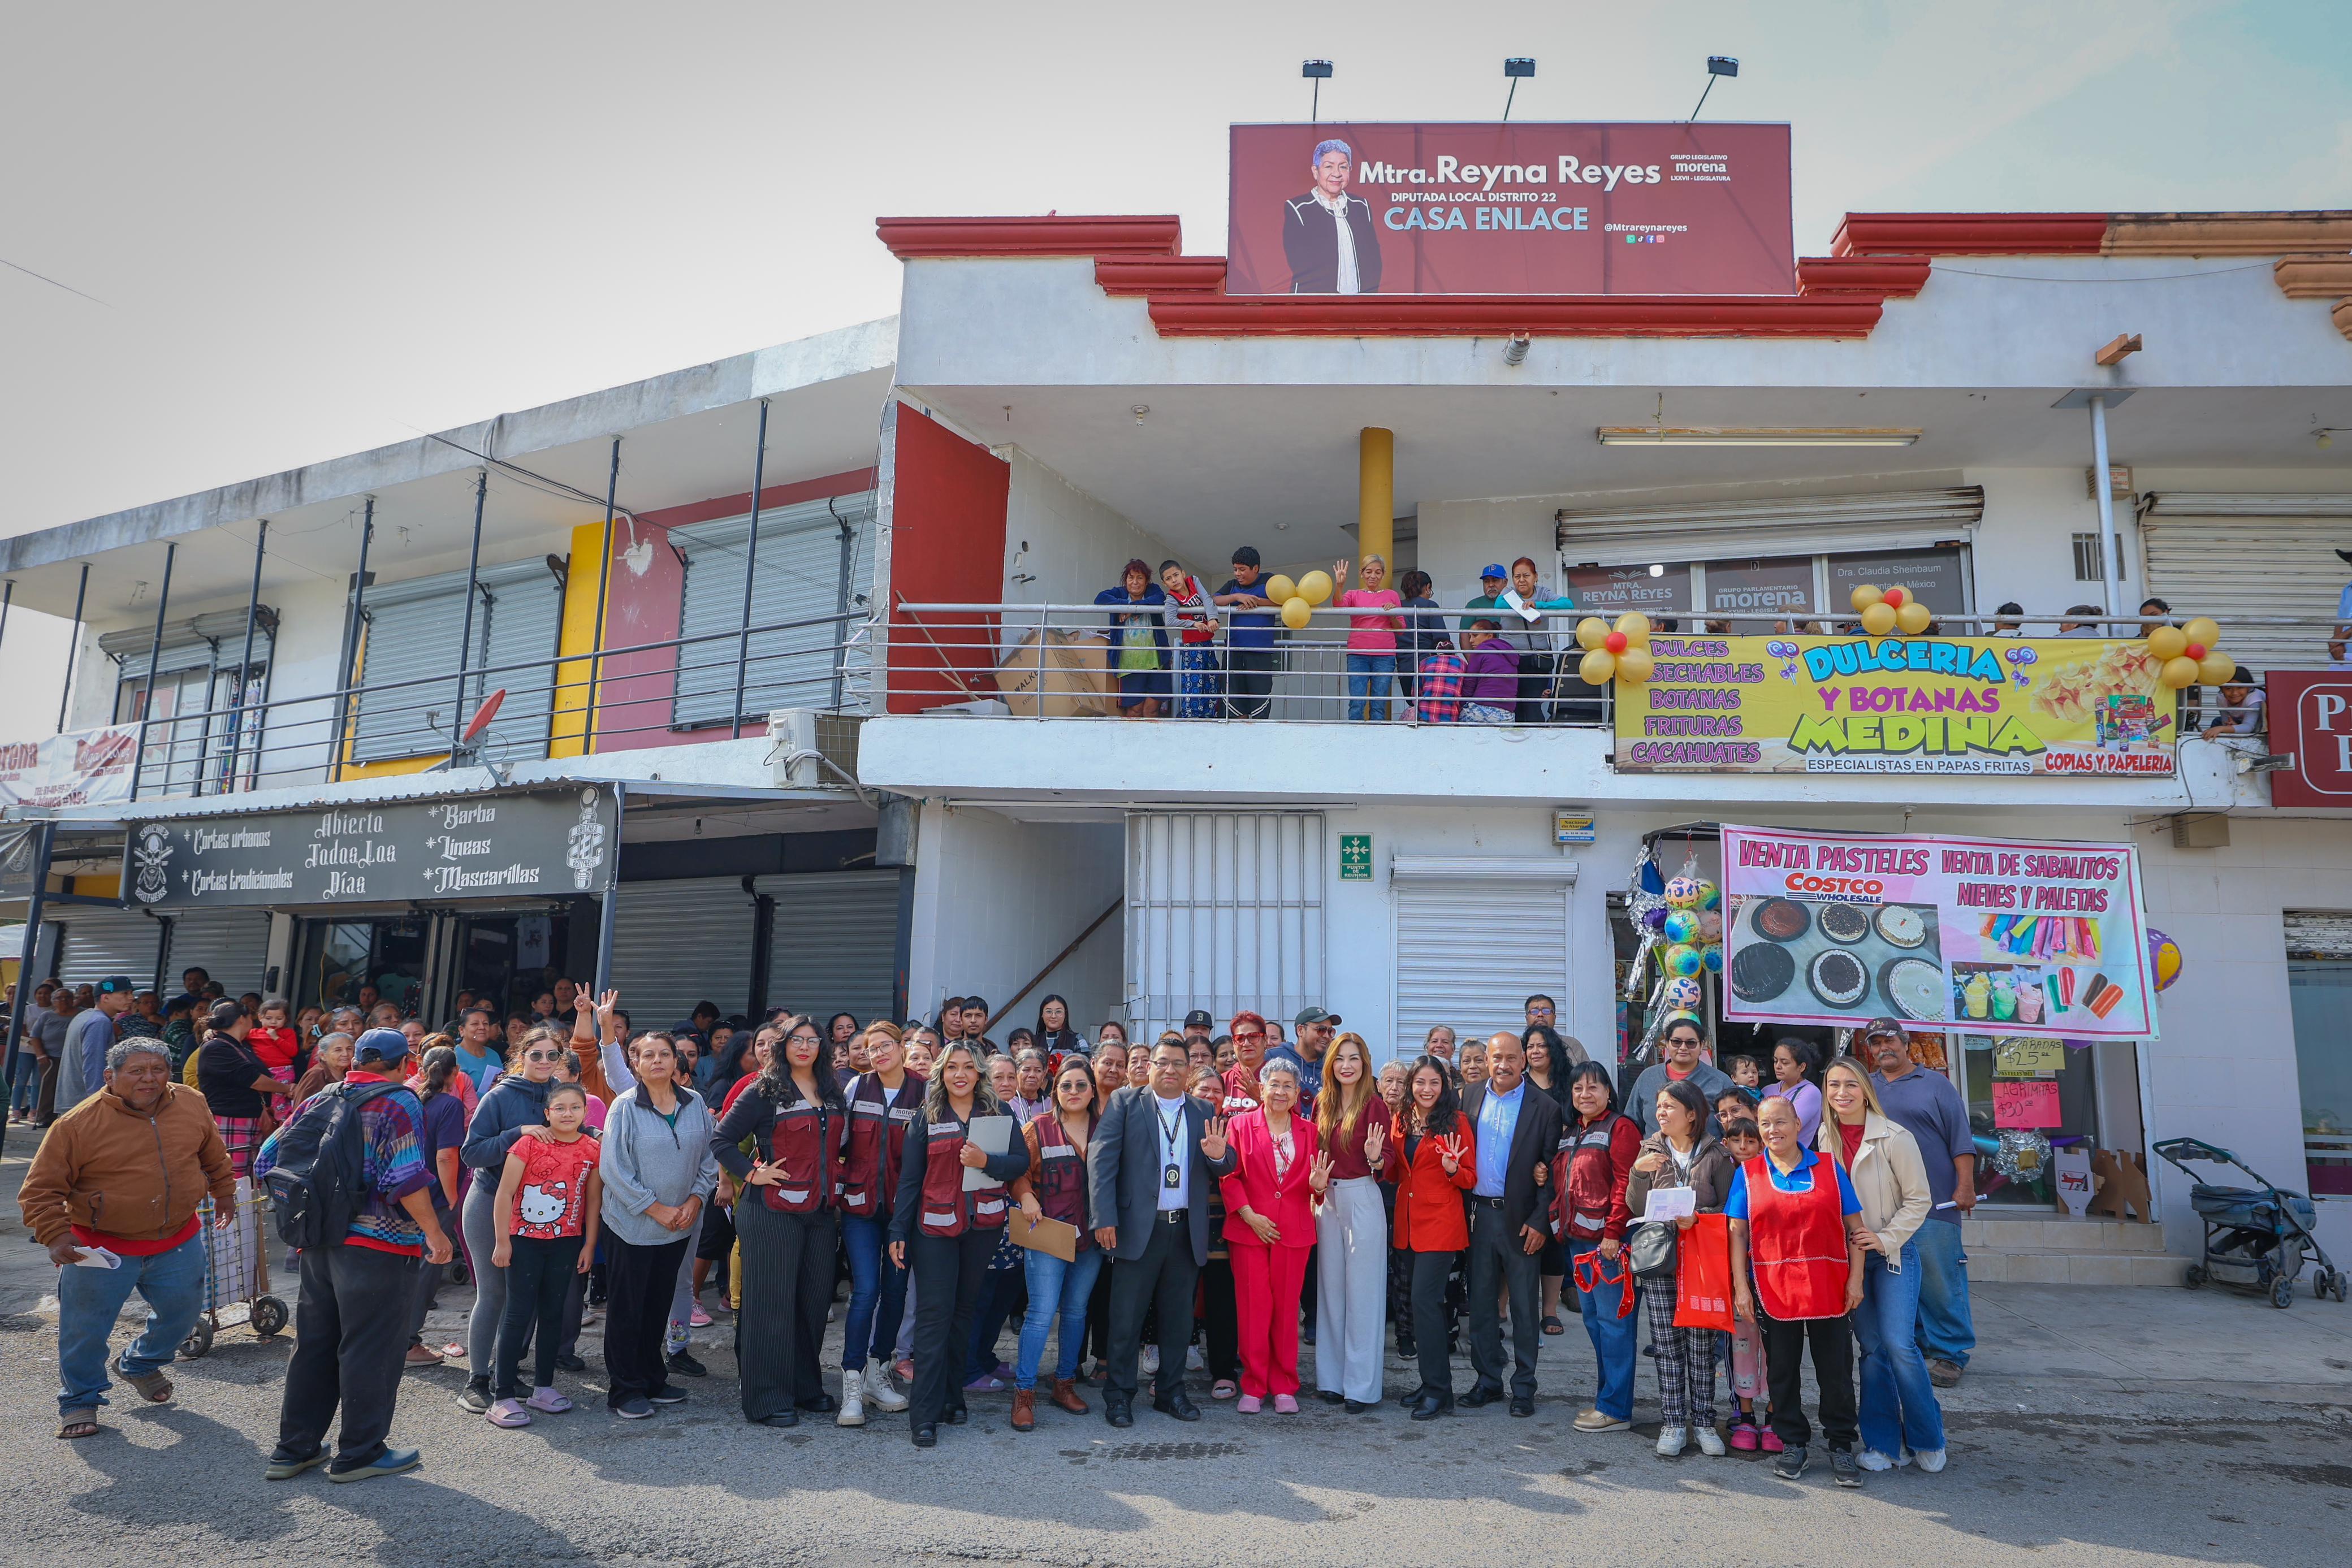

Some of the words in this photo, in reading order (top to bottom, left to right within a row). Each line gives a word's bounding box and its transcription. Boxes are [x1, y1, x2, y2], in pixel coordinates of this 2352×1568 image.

[1558, 155, 1662, 191] Reyes
[1676, 162, 1727, 172] morena
[1391, 193, 1447, 202] DIPUTADA
[1449, 193, 1486, 202] LOCAL
[1488, 193, 1538, 202] DISTRITO
[1541, 193, 1557, 202] 22
[1384, 207, 1469, 231] CASA
[1476, 207, 1589, 231] ENLACE
[1605, 223, 1688, 233] @Mtrareynareyes
[1838, 568, 1855, 577] Dra.
[1858, 567, 1890, 575] Claudia
[1893, 565, 1942, 574] Sheinbaum
[1583, 590, 1628, 602] REYNA
[1631, 588, 1672, 600] REYES
[1715, 591, 1806, 608] morena
[1651, 640, 1730, 658] DULCES
[1804, 639, 2005, 683] DULCERIA
[1646, 662, 1765, 683] SECHABLES
[1650, 688, 1741, 709] BOTANAS
[1818, 686, 1841, 712] Y
[1849, 686, 2001, 713] BOTANAS
[1645, 715, 1743, 737] FRITURAS
[1787, 714, 2048, 756] MEDINA
[1632, 742, 1761, 763] CACAHUATES
[2045, 752, 2093, 771] COPIAS
[2095, 753, 2107, 770] Y
[2108, 753, 2172, 772] PAPELERIA
[1808, 760, 1912, 771] ESPECIALISTAS
[1916, 761, 1934, 771] EN
[1938, 761, 1981, 771] PAPAS
[1984, 761, 2031, 772] FRITAS
[314, 811, 383, 839] Abierto
[439, 803, 495, 830] Barba
[139, 824, 170, 841] SANCHEZ
[193, 828, 229, 855] Cortes
[231, 826, 271, 848] urbanos
[305, 839, 358, 869] Todos
[358, 839, 396, 869] Los
[438, 835, 491, 861] Lineas
[1739, 839, 1811, 869] VENTA
[1817, 846, 1930, 876] PASTELES
[434, 863, 540, 893] Mascarillas
[1942, 850, 1994, 876] VENTA
[1998, 853, 2021, 877] DE
[2024, 854, 2120, 881] SABALITOS
[191, 869, 227, 896] Cortes
[230, 866, 293, 891] tradicionales
[322, 870, 366, 900] Días
[1785, 872, 1884, 895] COSTCO
[1816, 893, 1882, 904] WHOLESALE
[1957, 882, 2016, 908] NIEVES
[2021, 885, 2033, 909] Y
[2035, 886, 2108, 912] PALETAS
[576, 1160, 594, 1194] Hello
[567, 1196, 582, 1227] Kitty
